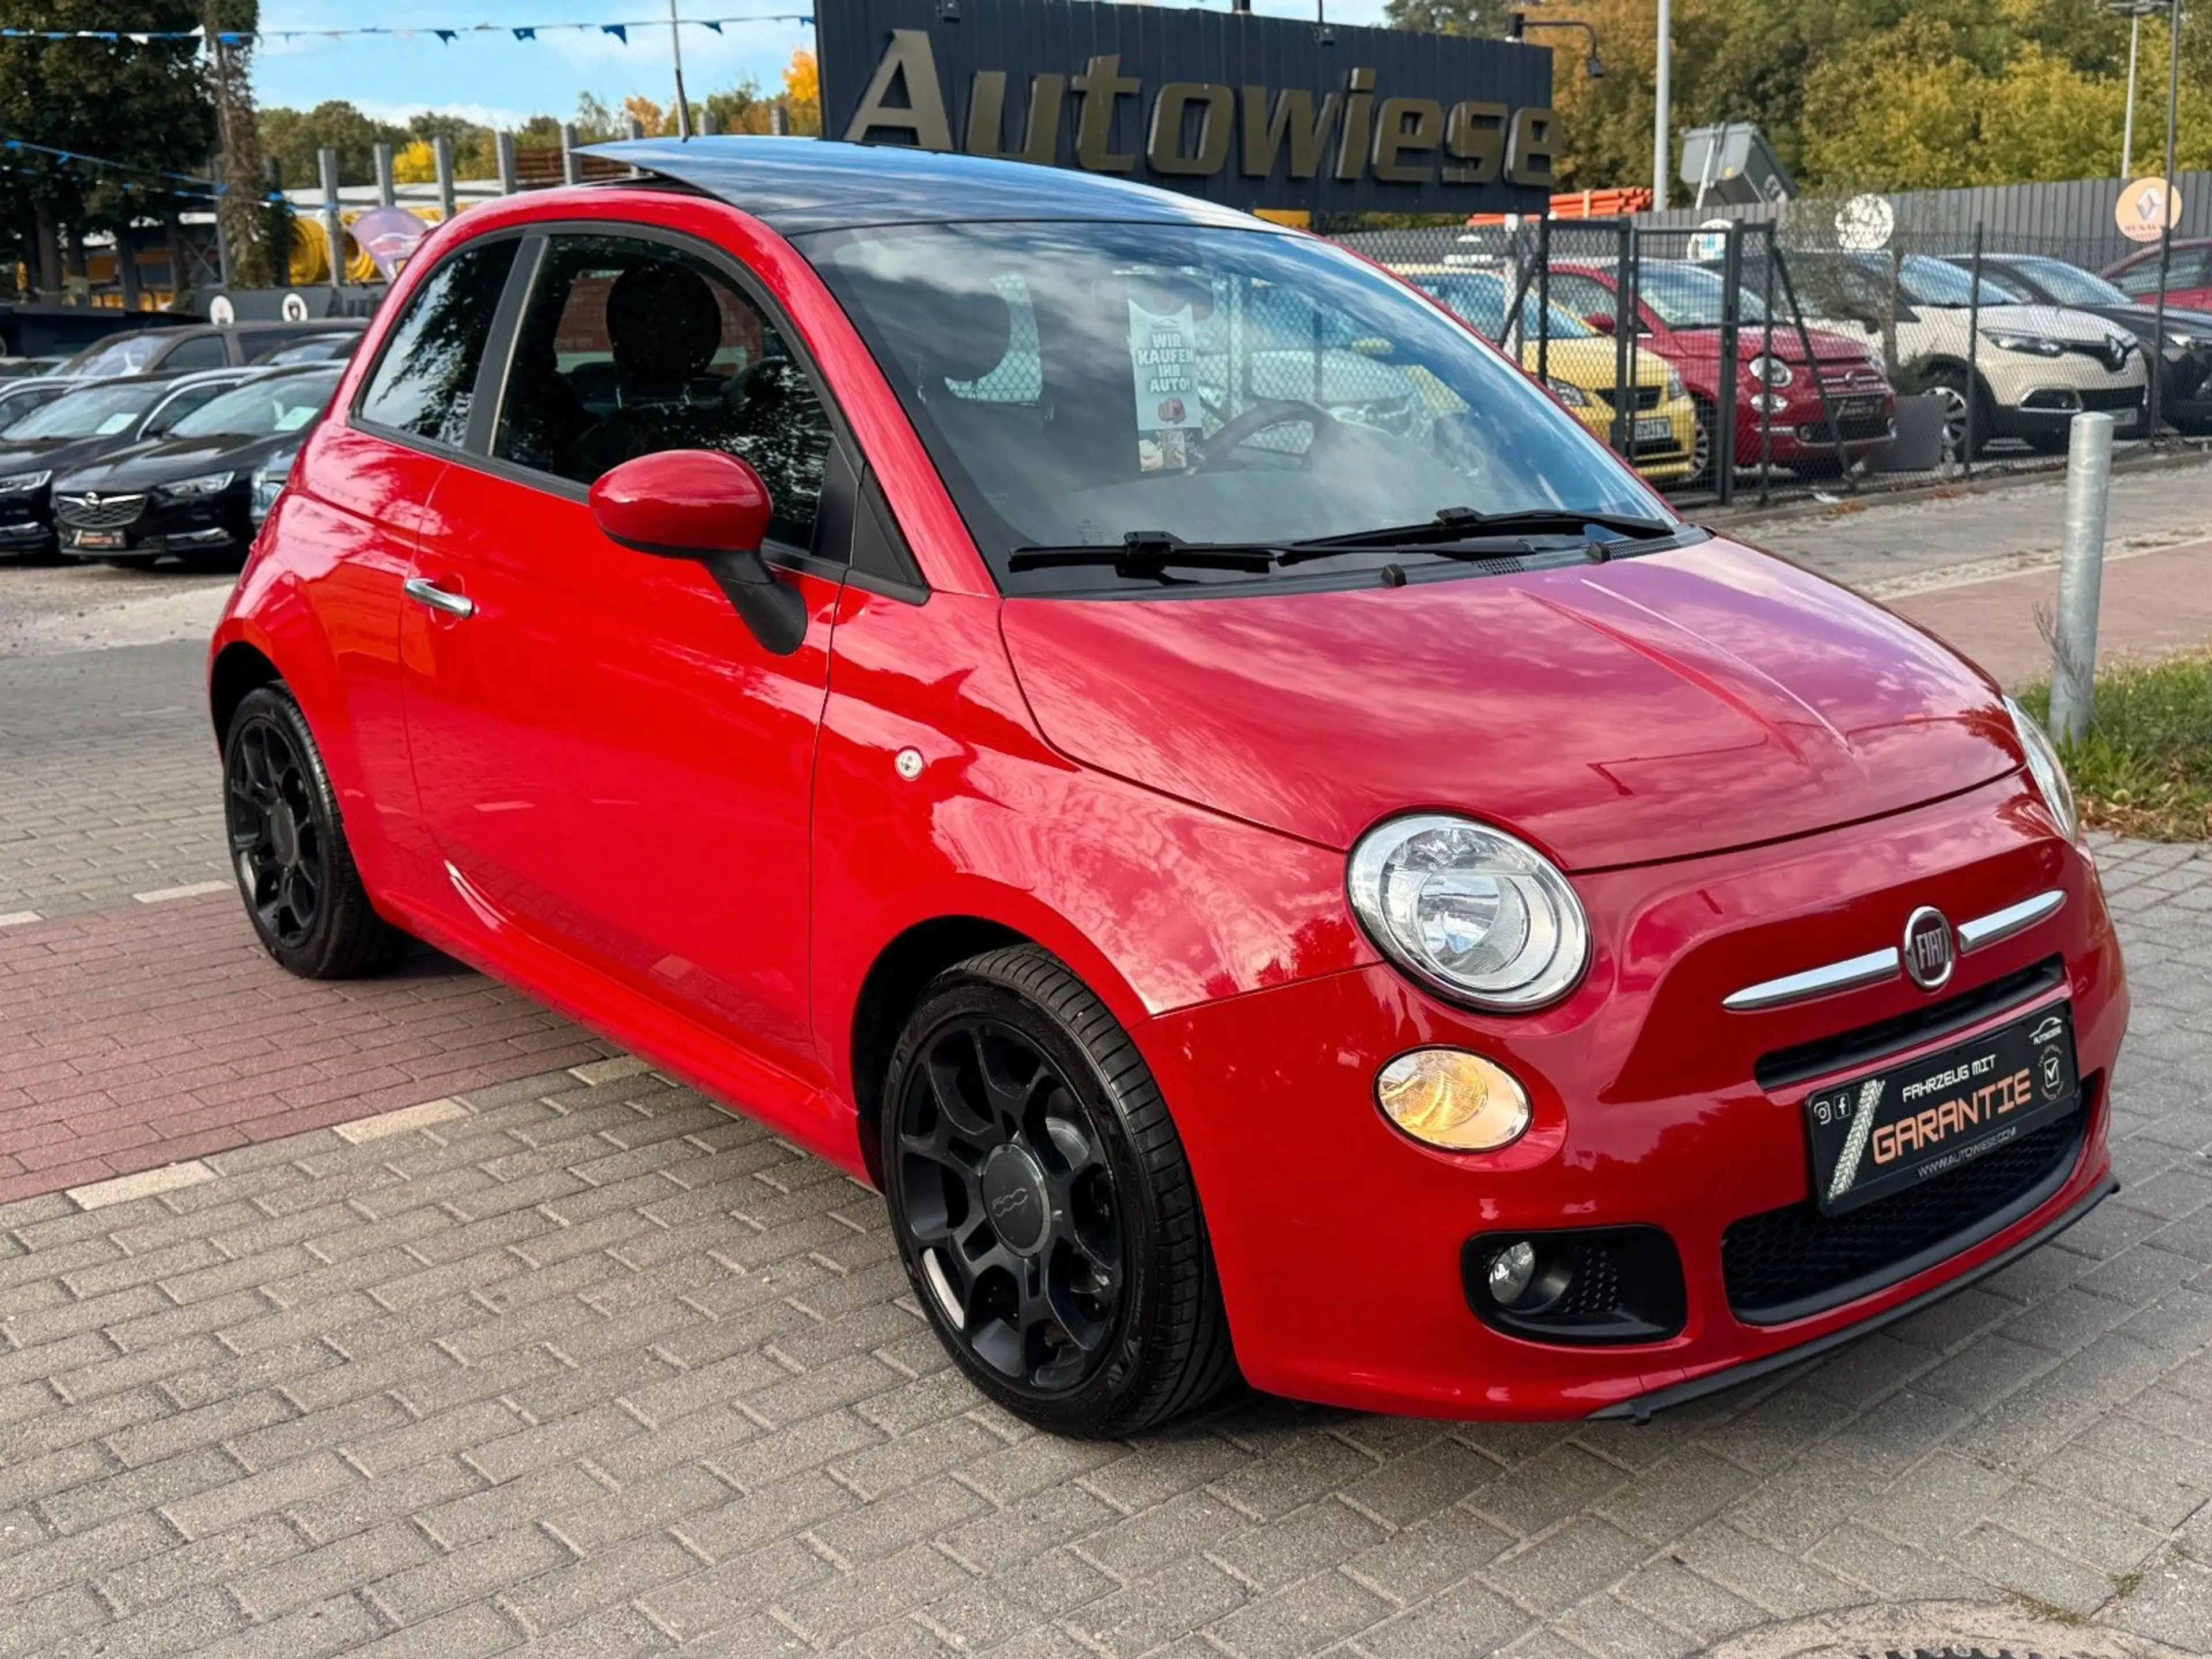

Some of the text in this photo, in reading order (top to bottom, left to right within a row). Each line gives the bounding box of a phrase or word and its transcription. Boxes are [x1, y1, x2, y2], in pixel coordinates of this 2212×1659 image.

[843, 28, 1562, 187] Autowiese
[1152, 334, 1180, 348] WIR
[1137, 349, 1194, 365] KAUFEN
[1158, 363, 1181, 377] IHR
[1149, 377, 1191, 392] AUTO!
[1916, 927, 1944, 969] FIAT
[1902, 1054, 1996, 1103] FAHRZEUG MIT
[1872, 1067, 2032, 1165] GARANTIE
